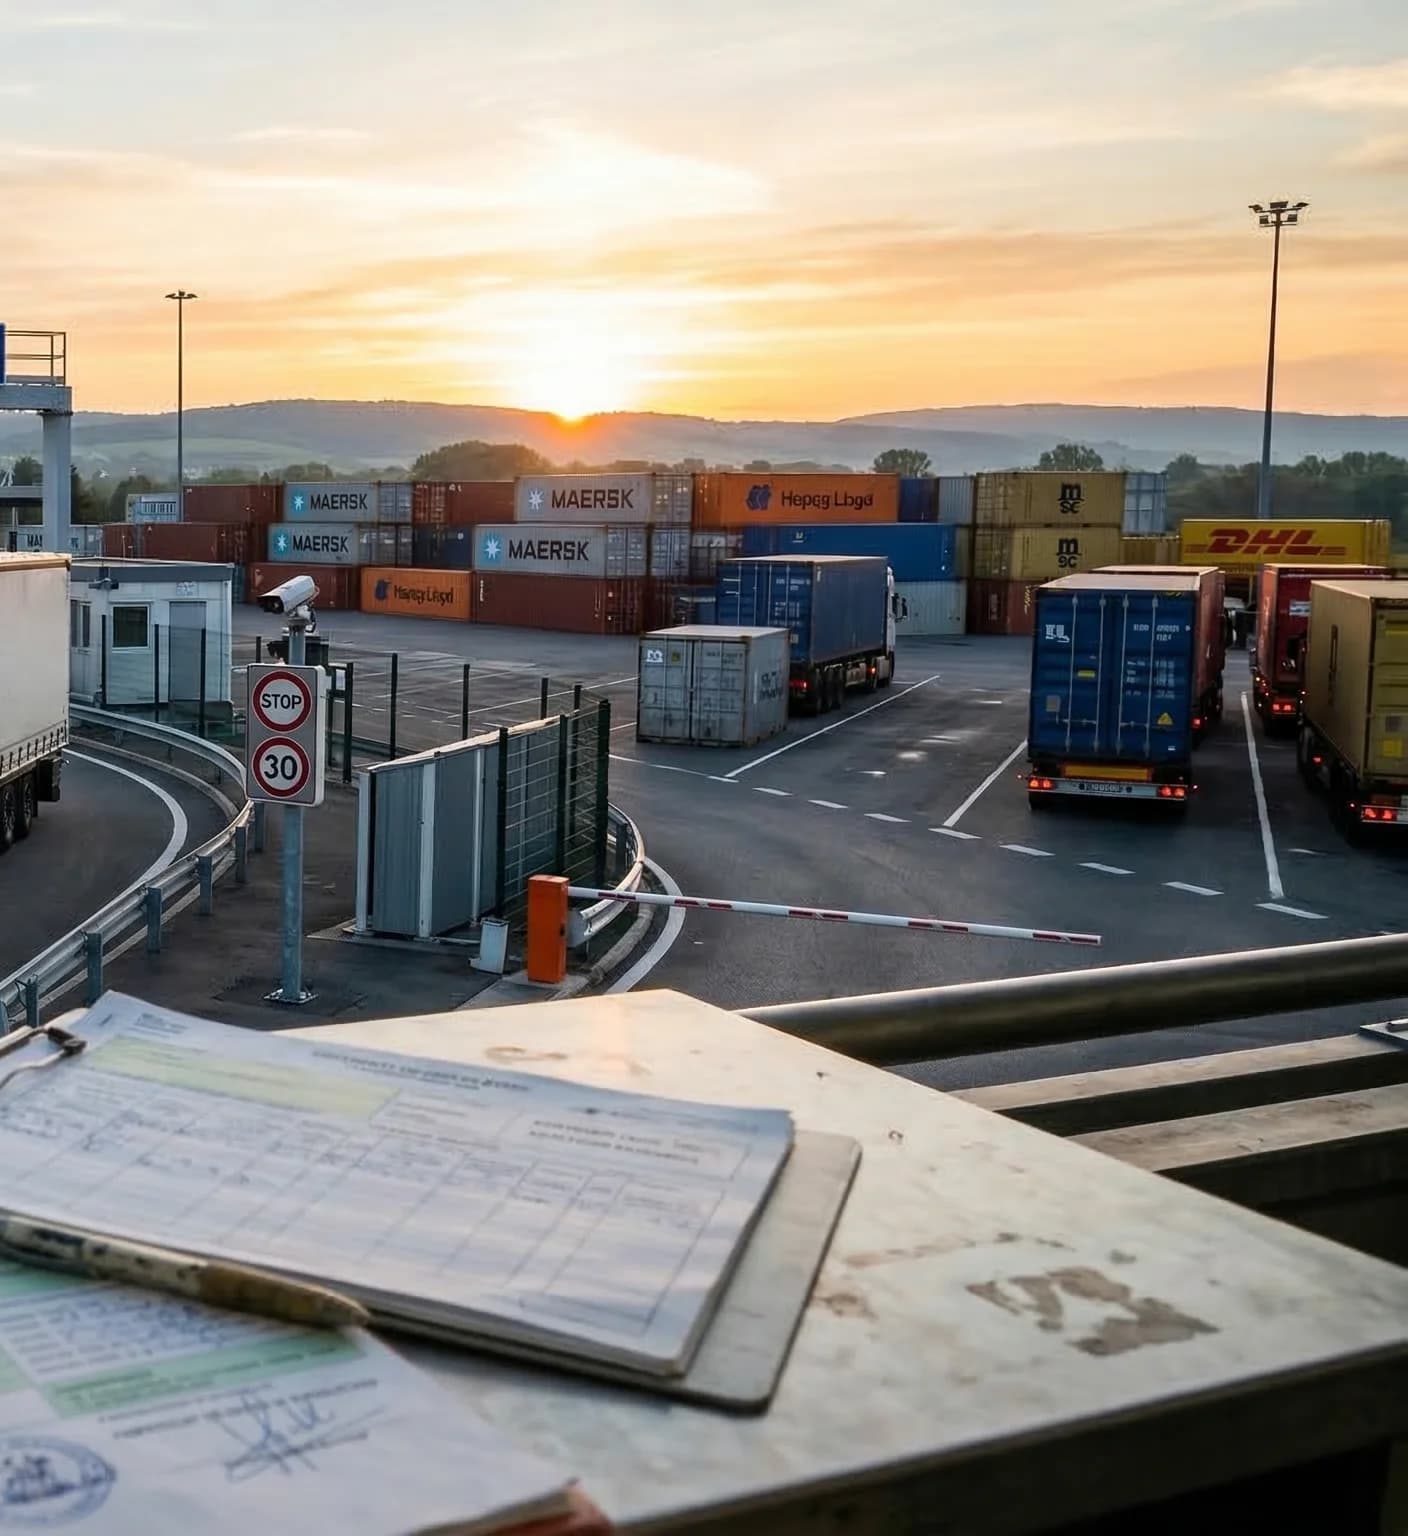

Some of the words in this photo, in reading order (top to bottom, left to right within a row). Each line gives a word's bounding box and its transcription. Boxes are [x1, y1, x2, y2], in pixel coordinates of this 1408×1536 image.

[310, 493, 368, 510] MAERSK
[552, 488, 634, 509] MAERSK
[292, 535, 349, 553] MAERSK
[509, 539, 590, 561] MAERSK
[1208, 528, 1323, 556] DHL
[261, 693, 302, 710] STOP
[263, 754, 298, 781] 30
